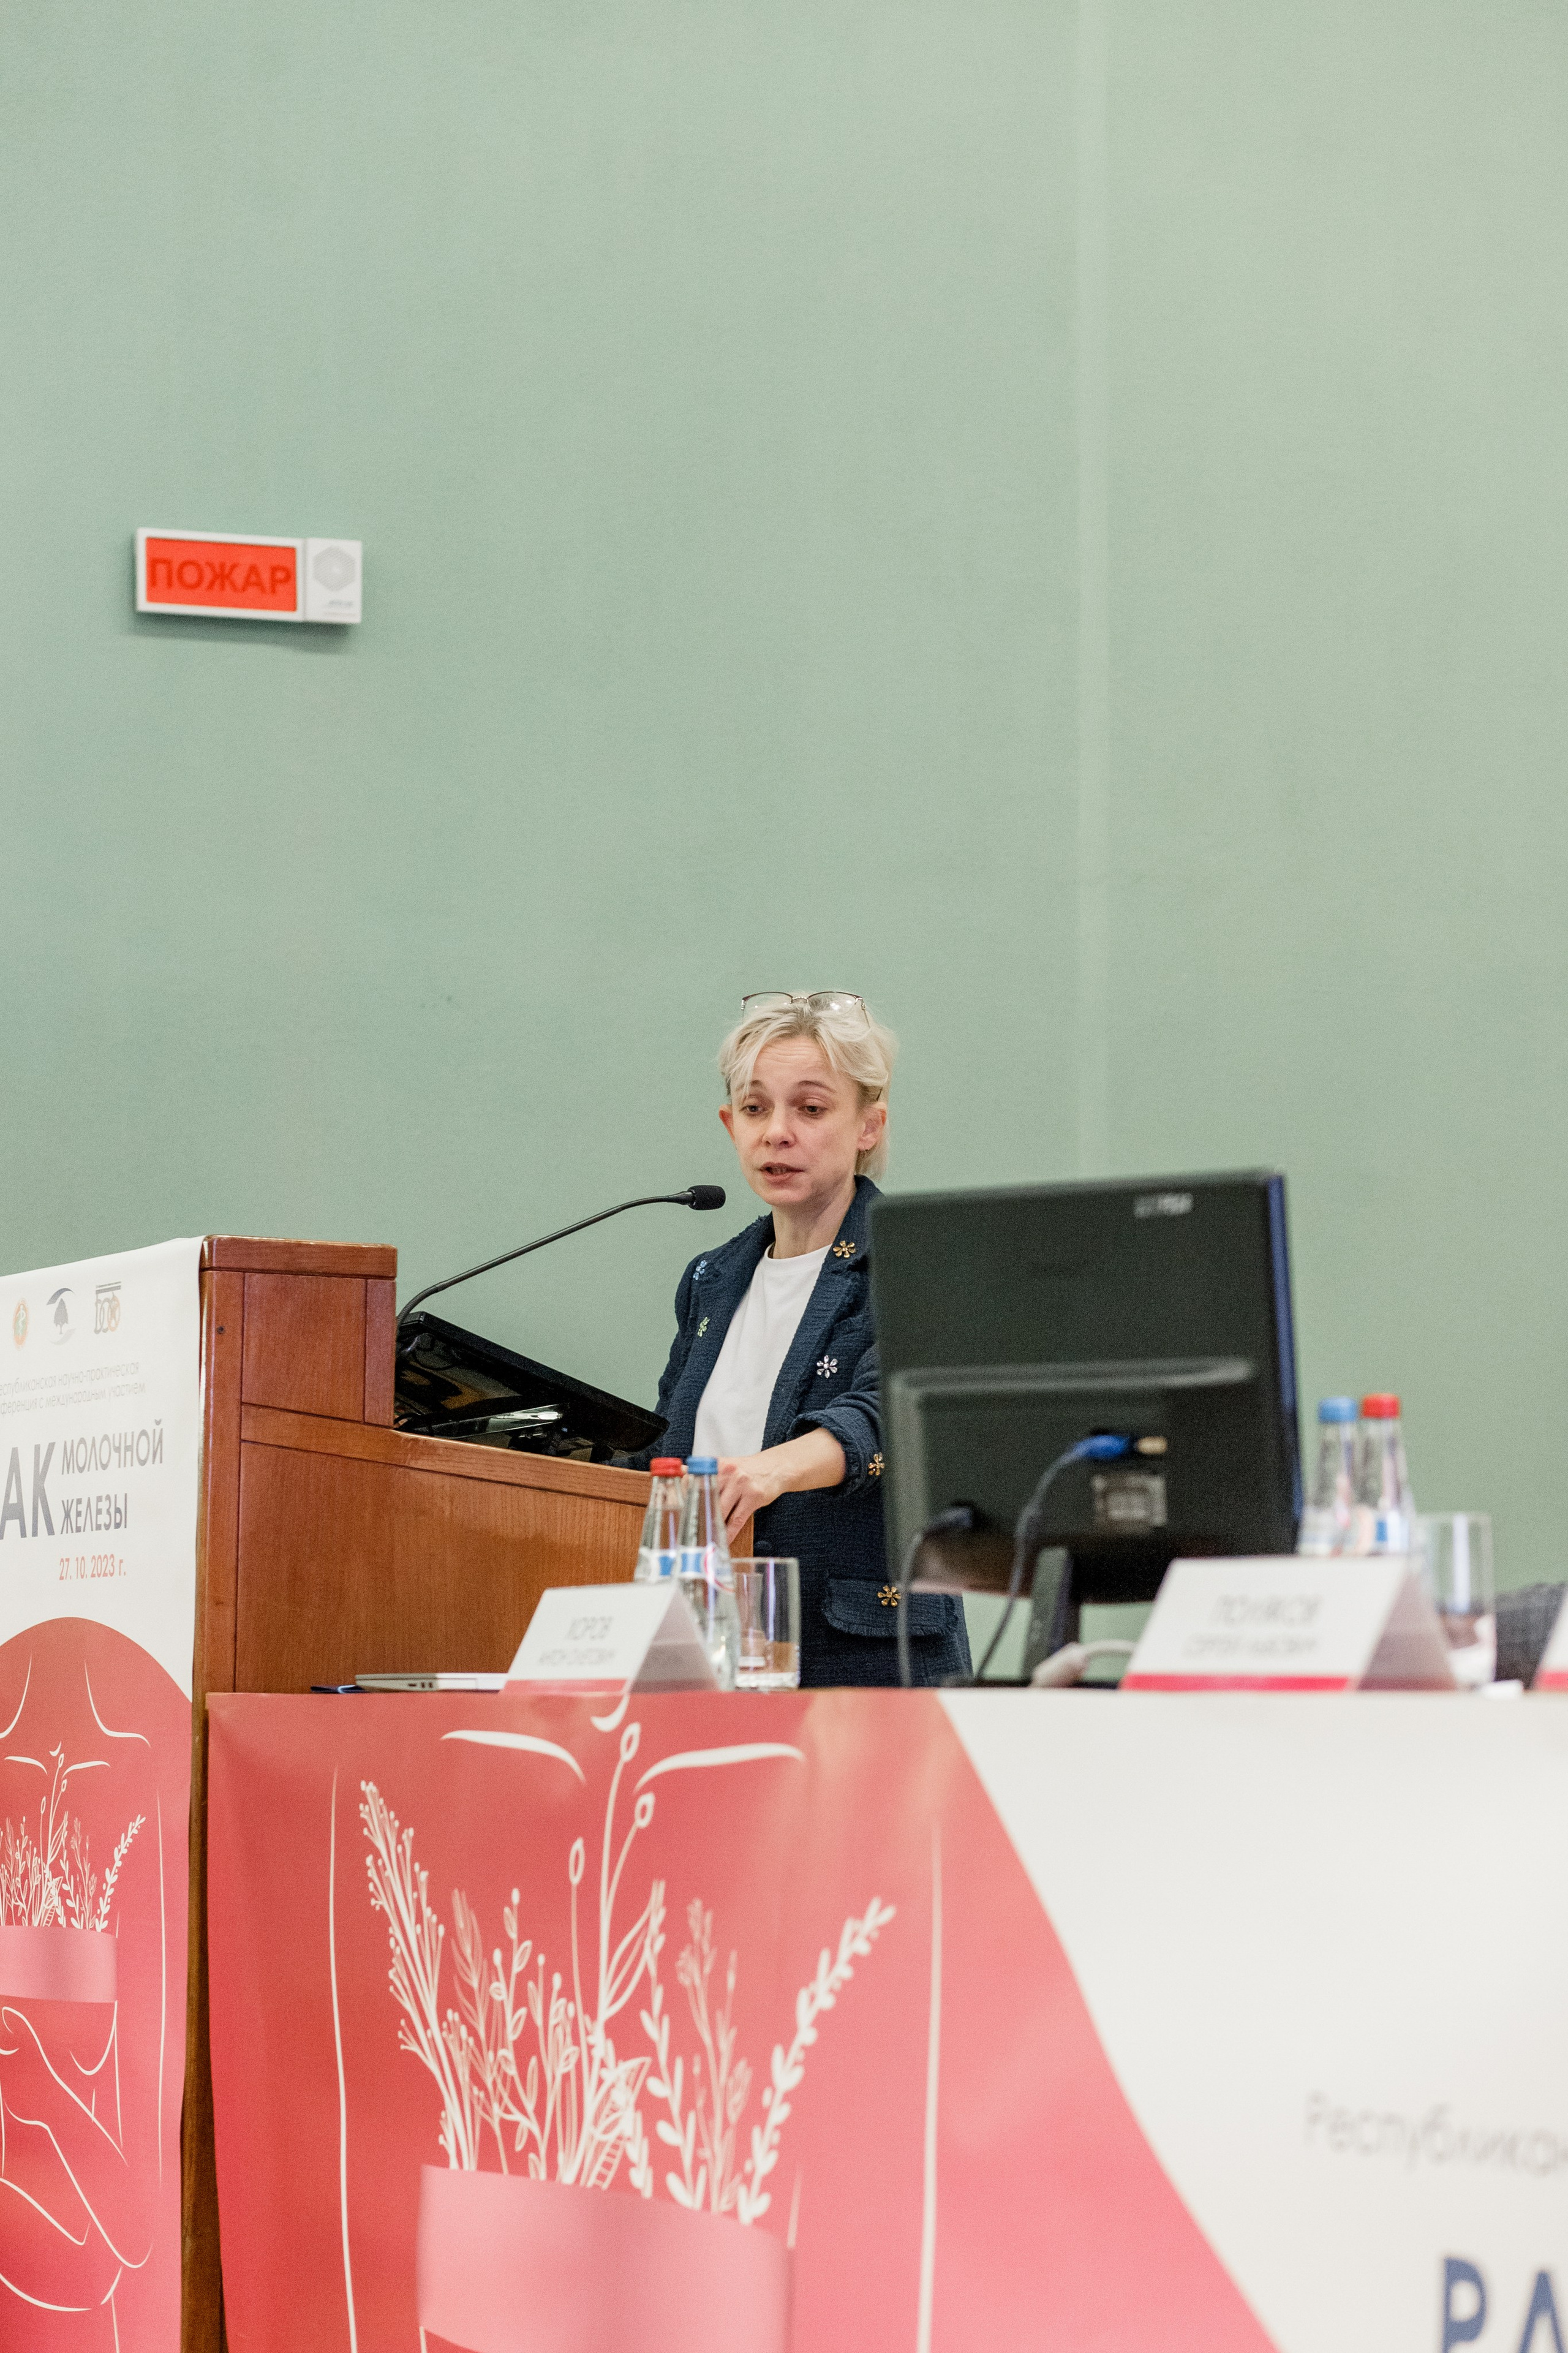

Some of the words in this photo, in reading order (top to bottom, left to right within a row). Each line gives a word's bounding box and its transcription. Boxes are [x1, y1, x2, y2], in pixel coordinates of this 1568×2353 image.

[150, 557, 292, 595] ПОЖАР
[62, 1419, 164, 1475] МОЛОЧНОЙ
[61, 1493, 127, 1535] ЖЕЛЕЗЫ
[1305, 2089, 1568, 2177] Республика
